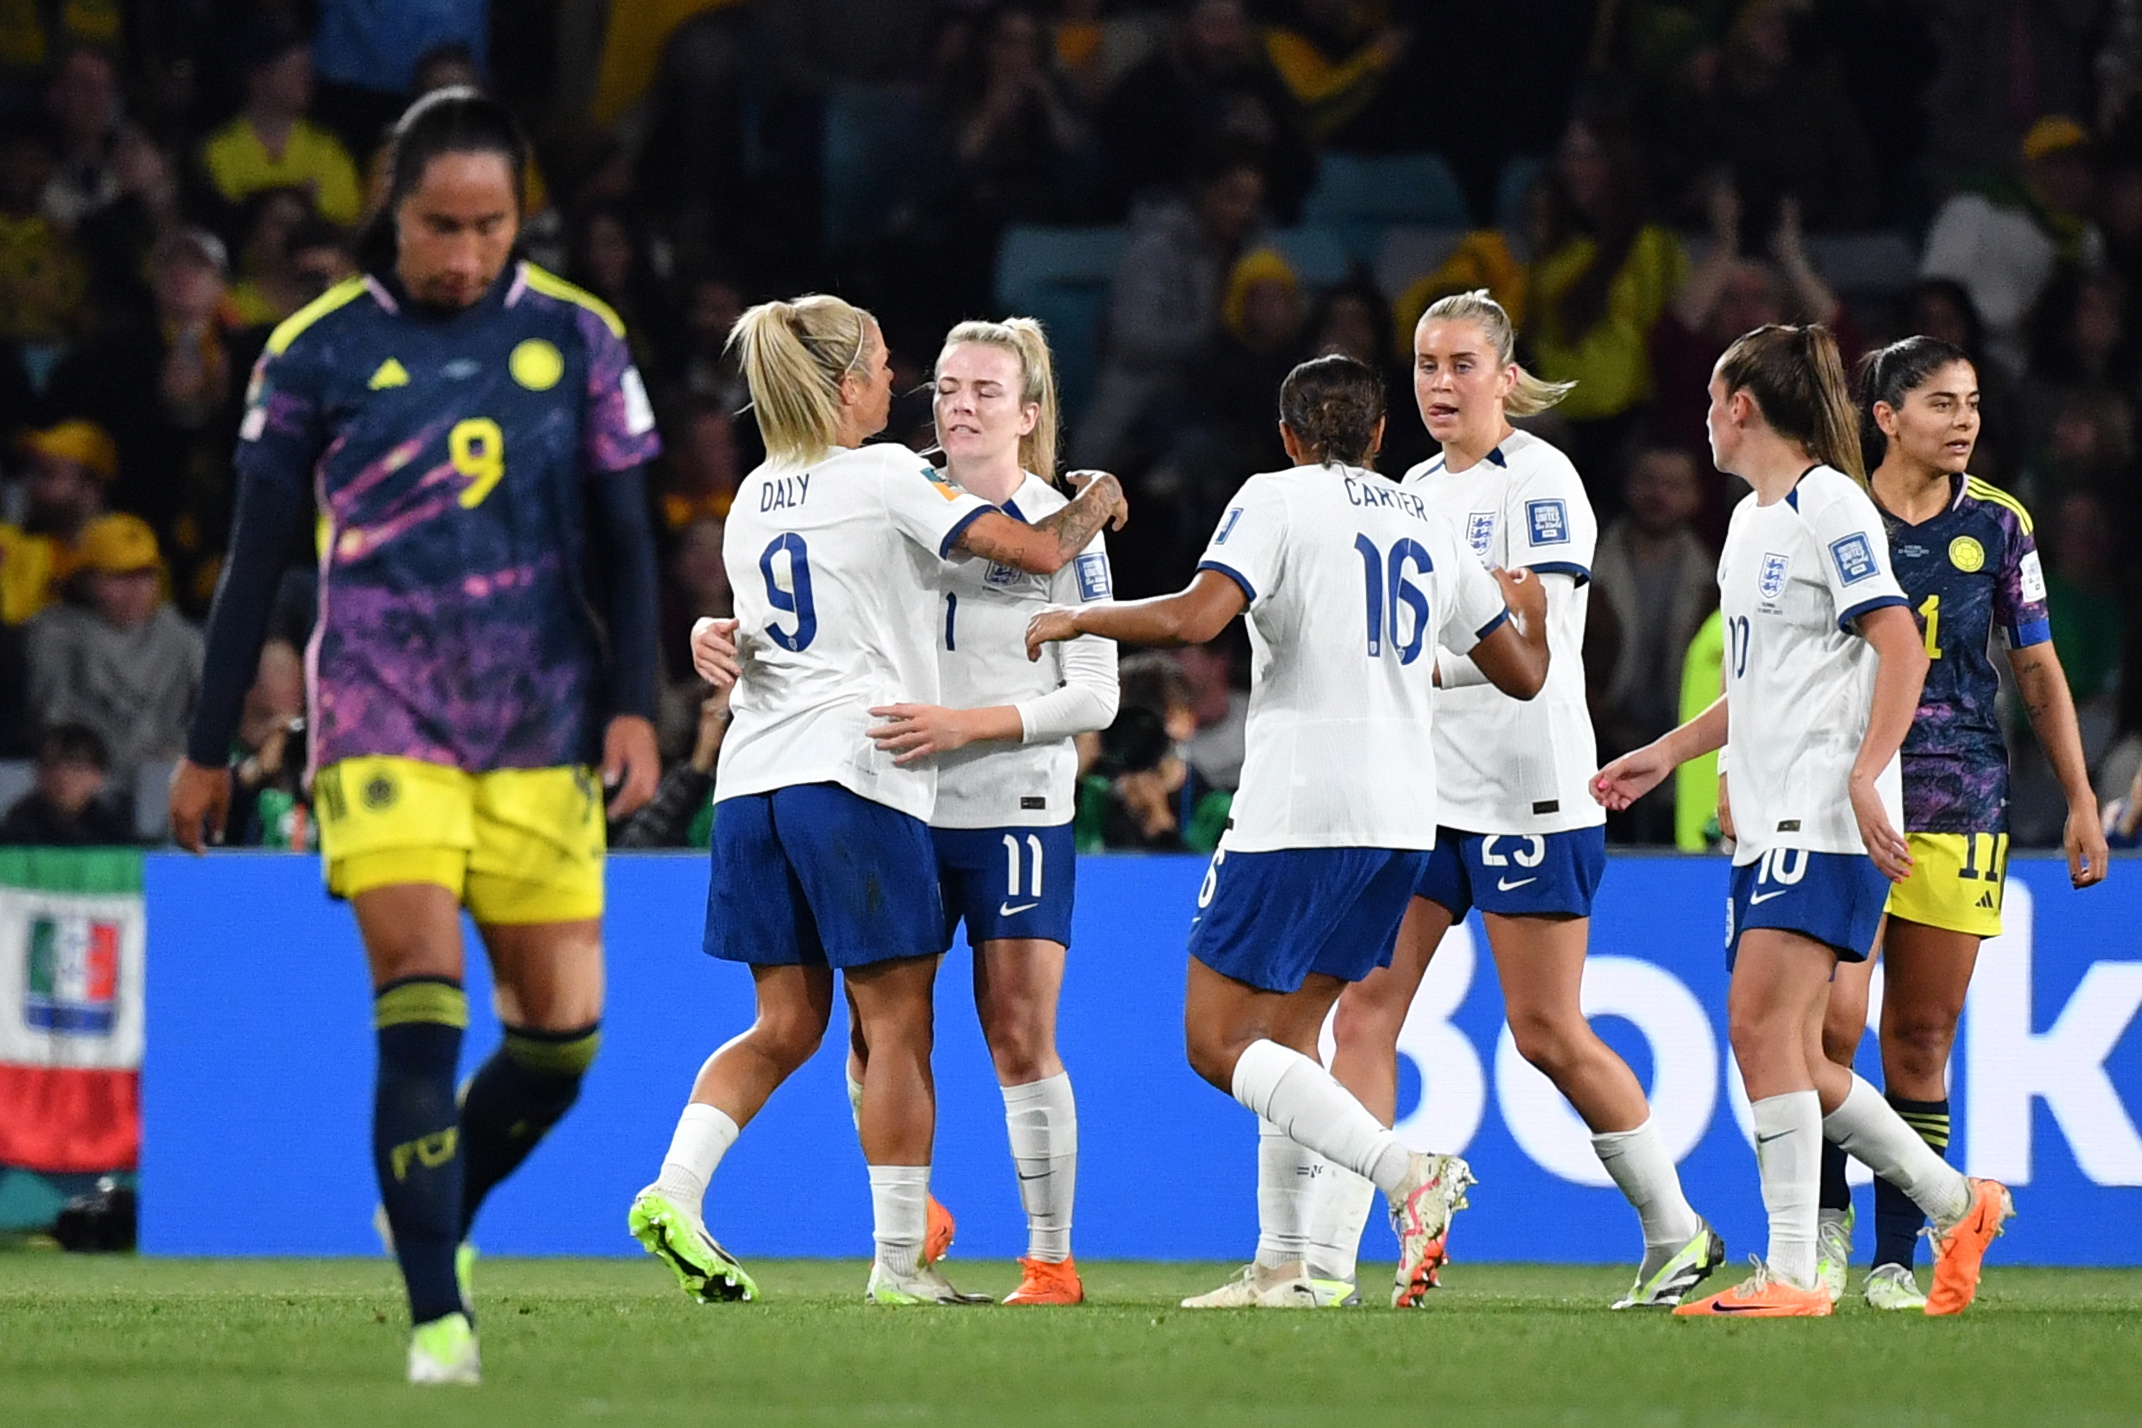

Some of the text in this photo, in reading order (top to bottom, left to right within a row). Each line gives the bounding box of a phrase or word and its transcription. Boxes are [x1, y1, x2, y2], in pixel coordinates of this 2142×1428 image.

[448, 416, 505, 509] 9
[760, 473, 810, 513] DALY
[1344, 477, 1428, 522] CARTER
[759, 532, 817, 653] 9
[1354, 532, 1434, 665] 16
[1729, 615, 1750, 679] 10
[1002, 833, 1043, 897] 11
[1198, 847, 1225, 908] 6
[1757, 847, 1809, 885] 10
[1958, 832, 1999, 882] 11
[1317, 877, 2142, 1188] Bok
